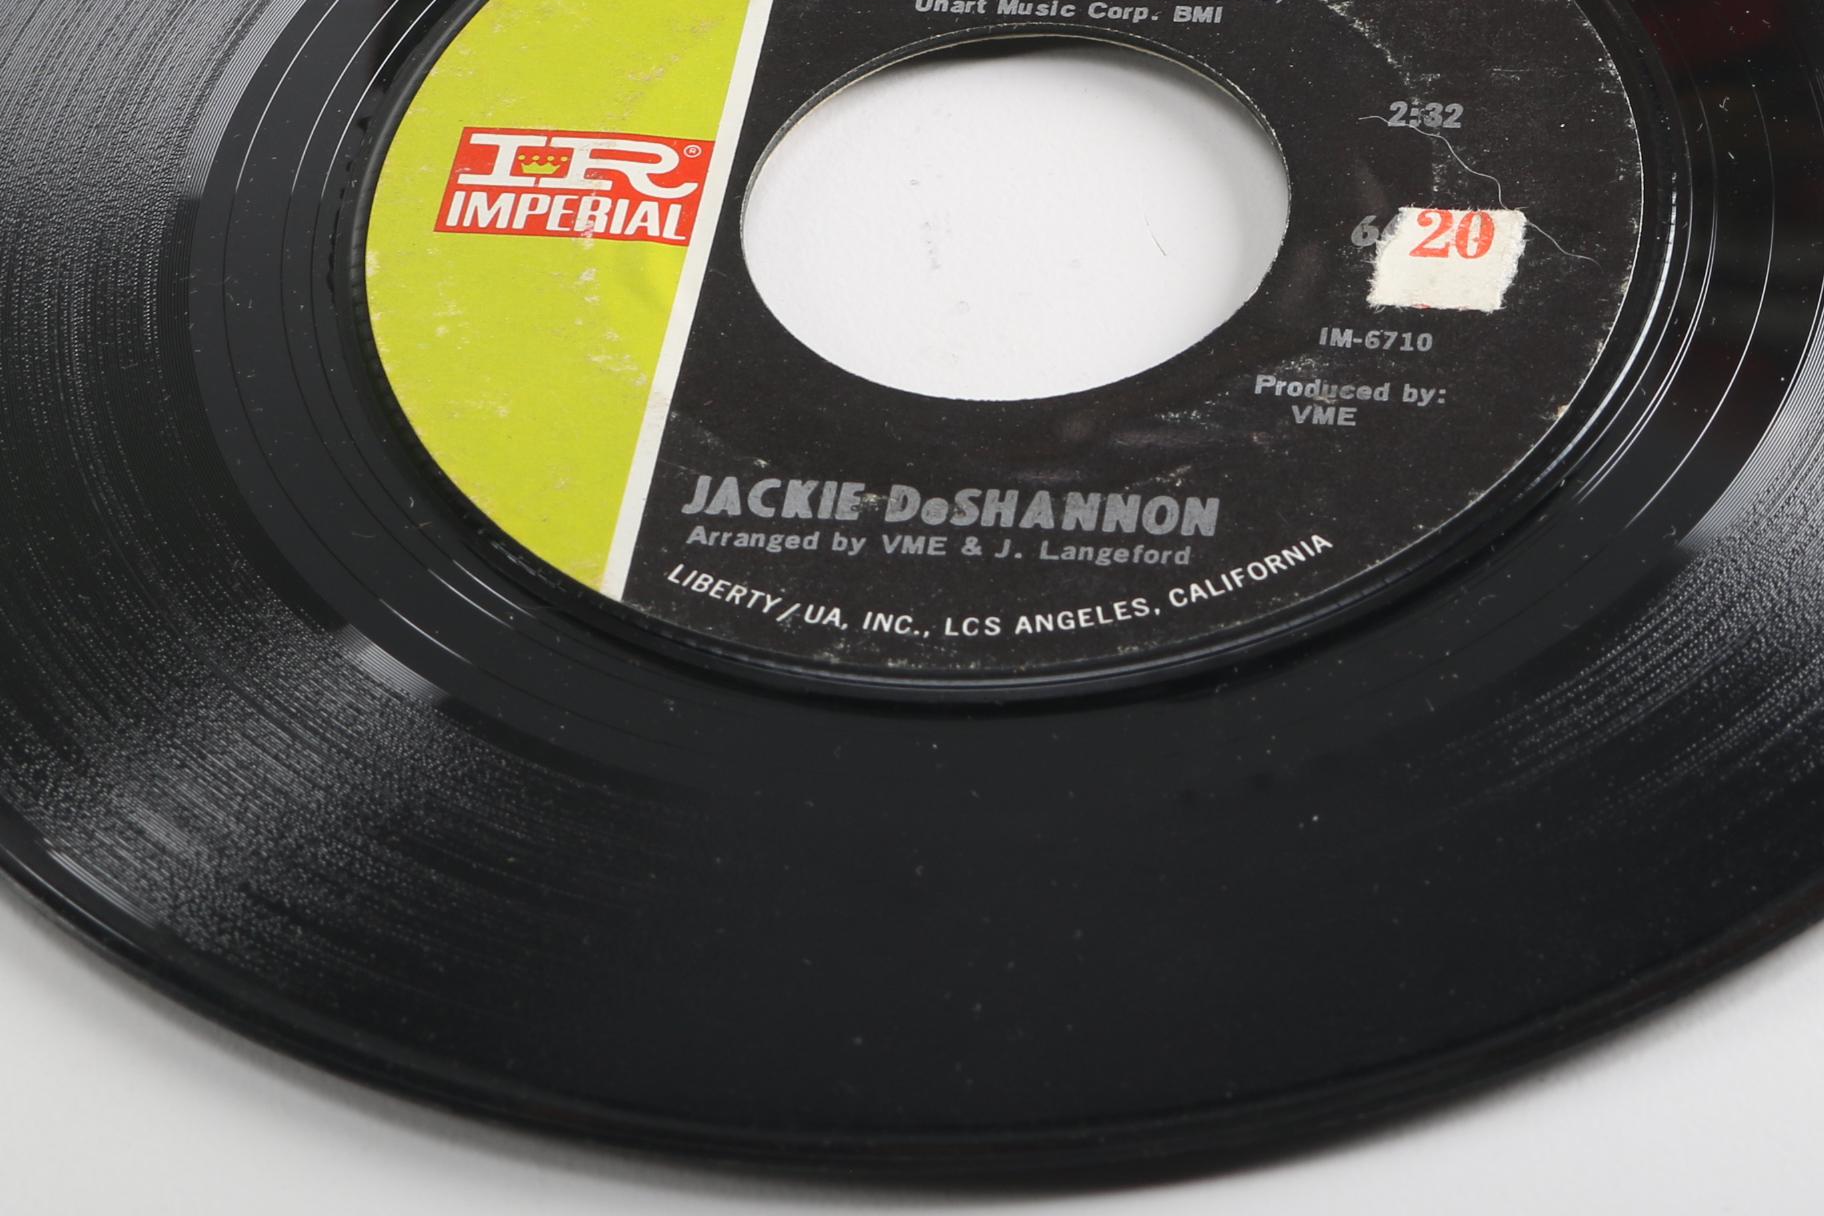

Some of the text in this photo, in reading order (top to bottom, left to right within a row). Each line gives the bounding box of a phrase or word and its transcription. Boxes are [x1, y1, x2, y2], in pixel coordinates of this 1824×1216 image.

[996, 0, 1076, 20] Music
[1087, 1, 1160, 25] Corp.
[1172, 5, 1224, 24] BMI
[1387, 100, 1465, 130] 2:32
[444, 190, 687, 241] IMPERIAL
[1408, 208, 1496, 260] 20
[1318, 327, 1434, 352] IM-6710
[1253, 373, 1447, 405] Produced by:
[1291, 404, 1358, 427] VME
[681, 475, 1221, 538] JACKIE DeSHANNON
[685, 524, 1192, 568] Arranged by VME & J. Langeford
[861, 611, 930, 639] INC.,
[1014, 596, 1162, 635] ANGELES,
[1167, 533, 1335, 609] CALIFORNIA
